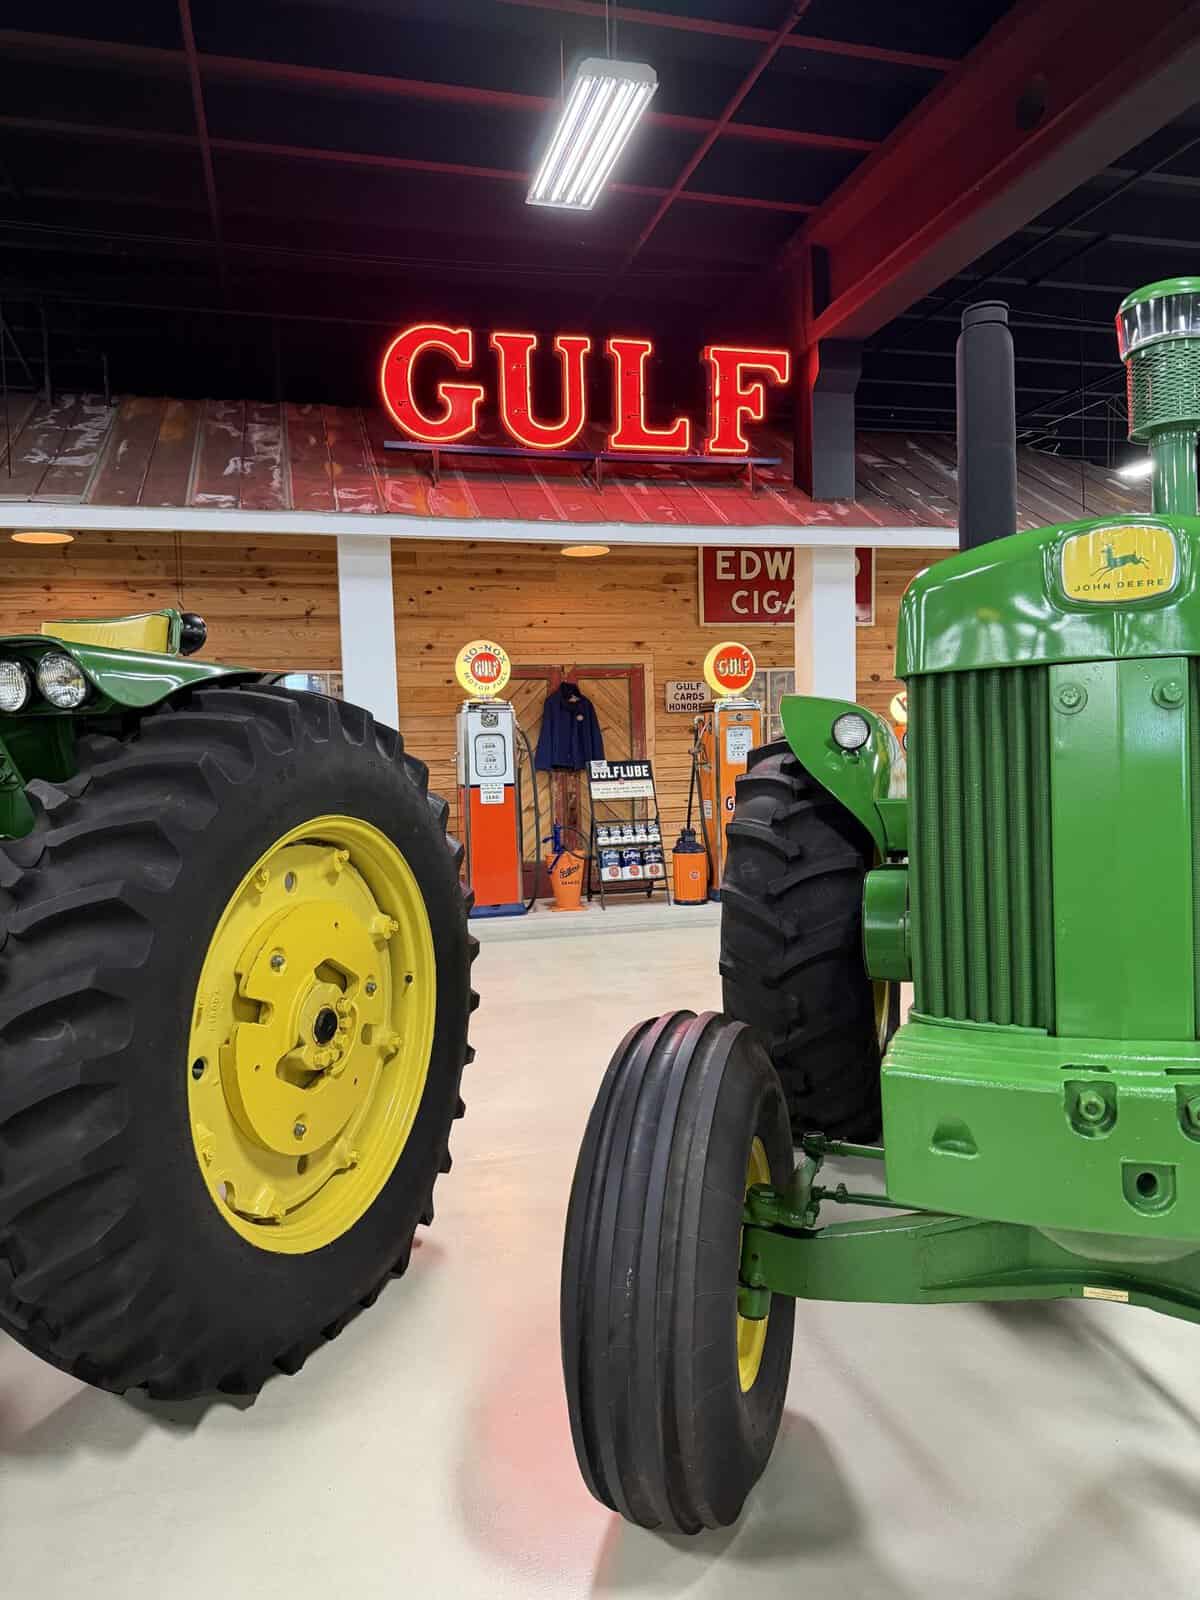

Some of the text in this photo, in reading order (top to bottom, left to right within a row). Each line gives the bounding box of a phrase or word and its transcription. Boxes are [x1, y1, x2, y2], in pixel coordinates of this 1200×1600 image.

[381, 324, 791, 455] GULF
[1074, 578, 1164, 592] JOHN DEERE
[731, 590, 796, 615] CIGA
[474, 659, 499, 678] GULF
[718, 657, 750, 677] GULF
[676, 682, 702, 690] GULF
[673, 692, 705, 701] CARDS
